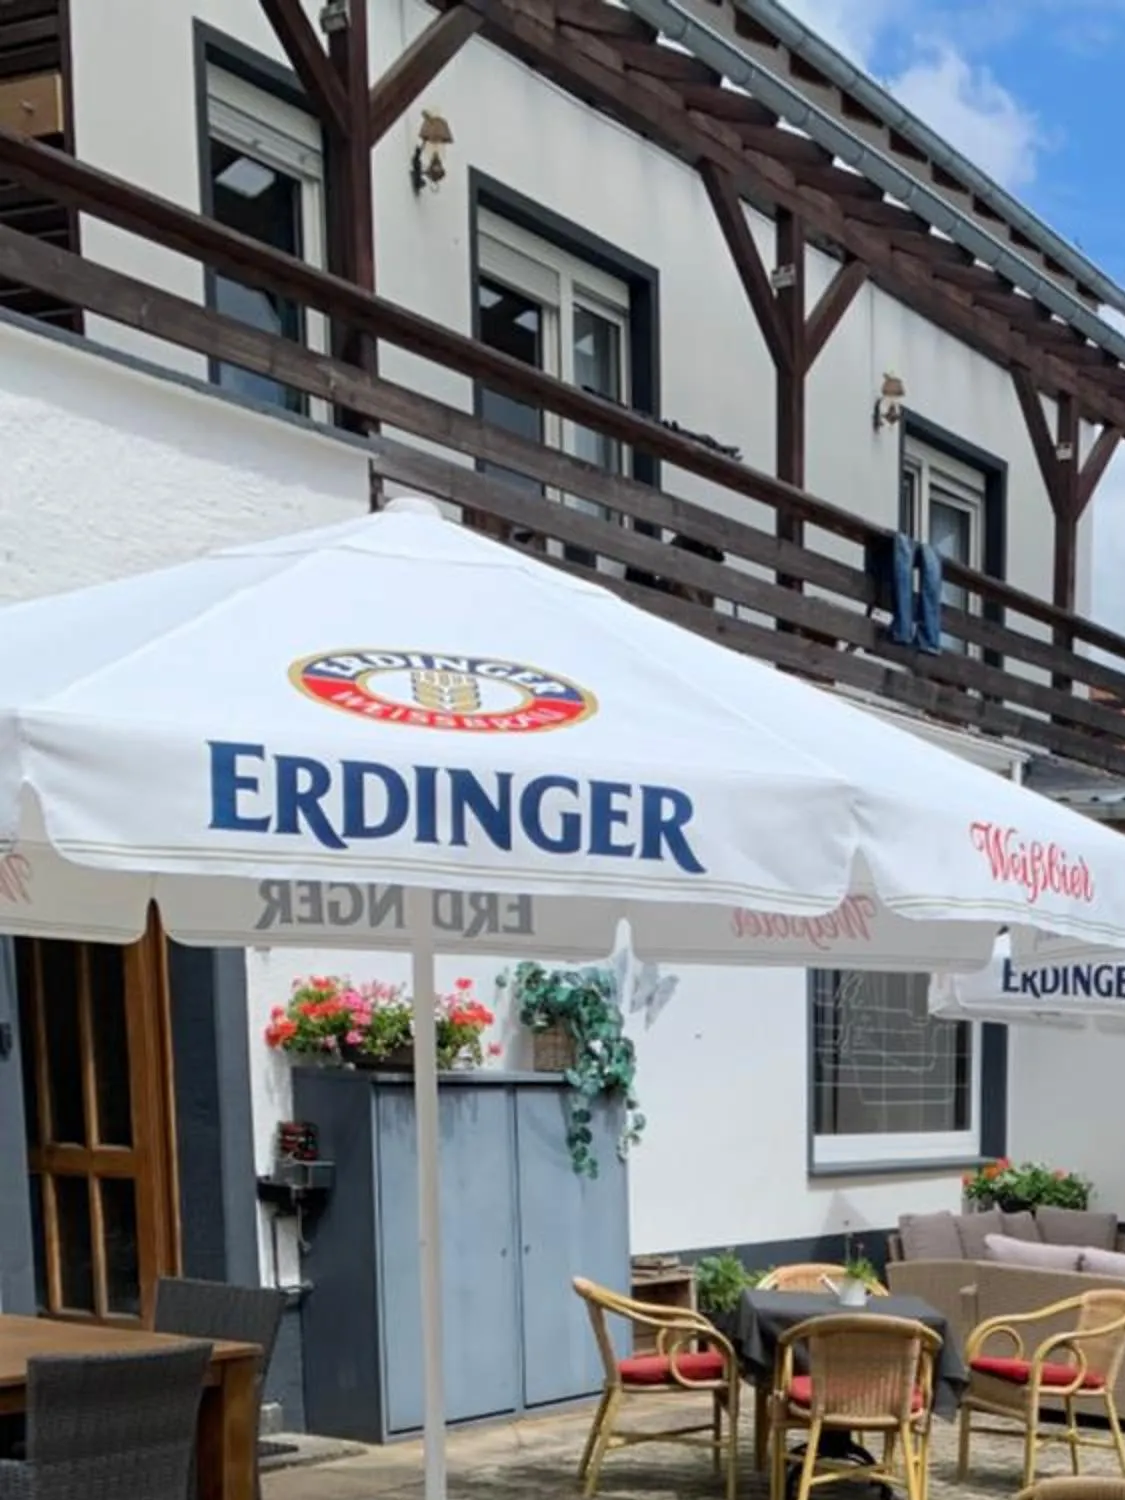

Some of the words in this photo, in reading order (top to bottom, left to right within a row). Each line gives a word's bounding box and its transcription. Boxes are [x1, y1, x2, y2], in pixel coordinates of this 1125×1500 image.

[311, 653, 567, 695] ERDINGER
[204, 739, 708, 874] ERDINGER
[969, 821, 1094, 904] Weißbier
